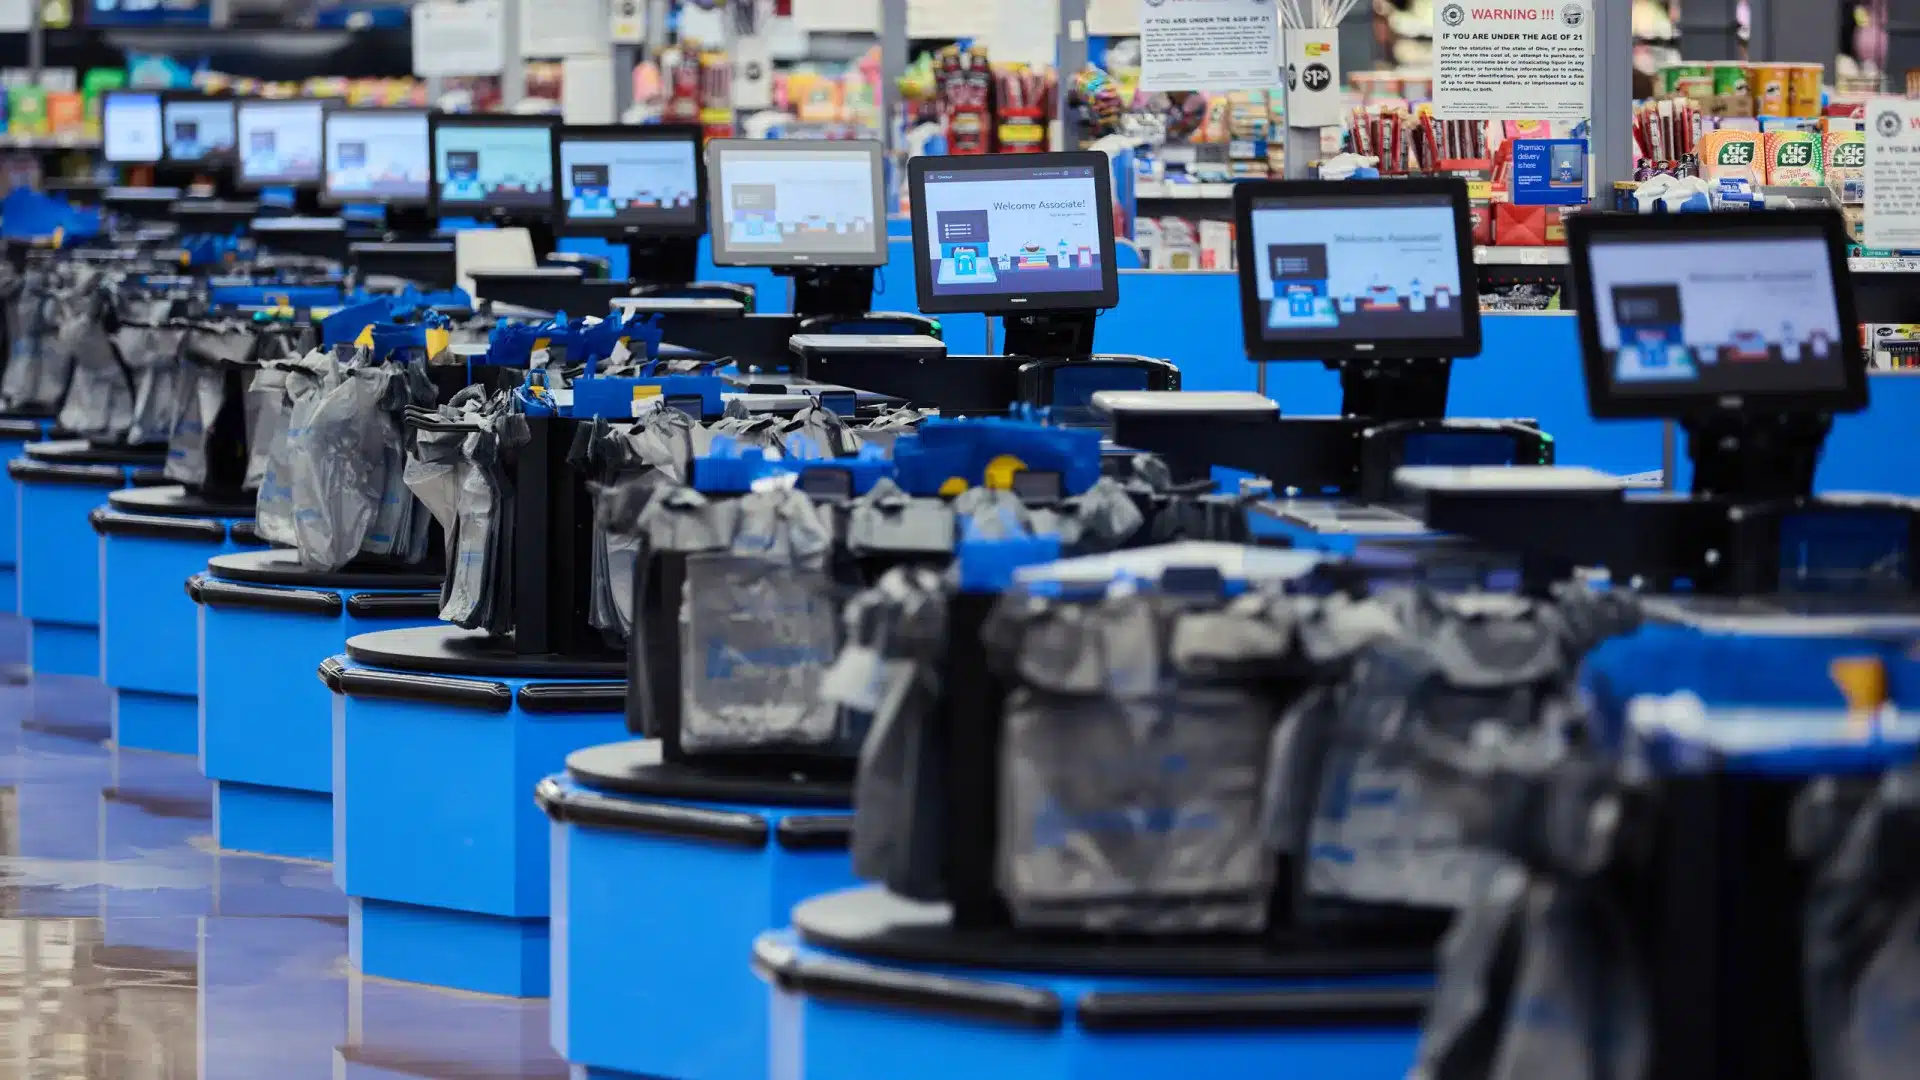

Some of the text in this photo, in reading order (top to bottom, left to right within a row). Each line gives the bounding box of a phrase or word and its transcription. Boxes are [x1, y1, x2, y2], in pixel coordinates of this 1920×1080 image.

[1472, 8, 1554, 20] WARNING !!!
[1728, 144, 1748, 154] tic
[1786, 144, 1807, 154] tic
[1843, 144, 1864, 155] tic
[1722, 153, 1748, 164] tac
[1781, 153, 1806, 164] tac
[1836, 154, 1864, 165] tac
[993, 200, 1086, 210] Welcome Associate!
